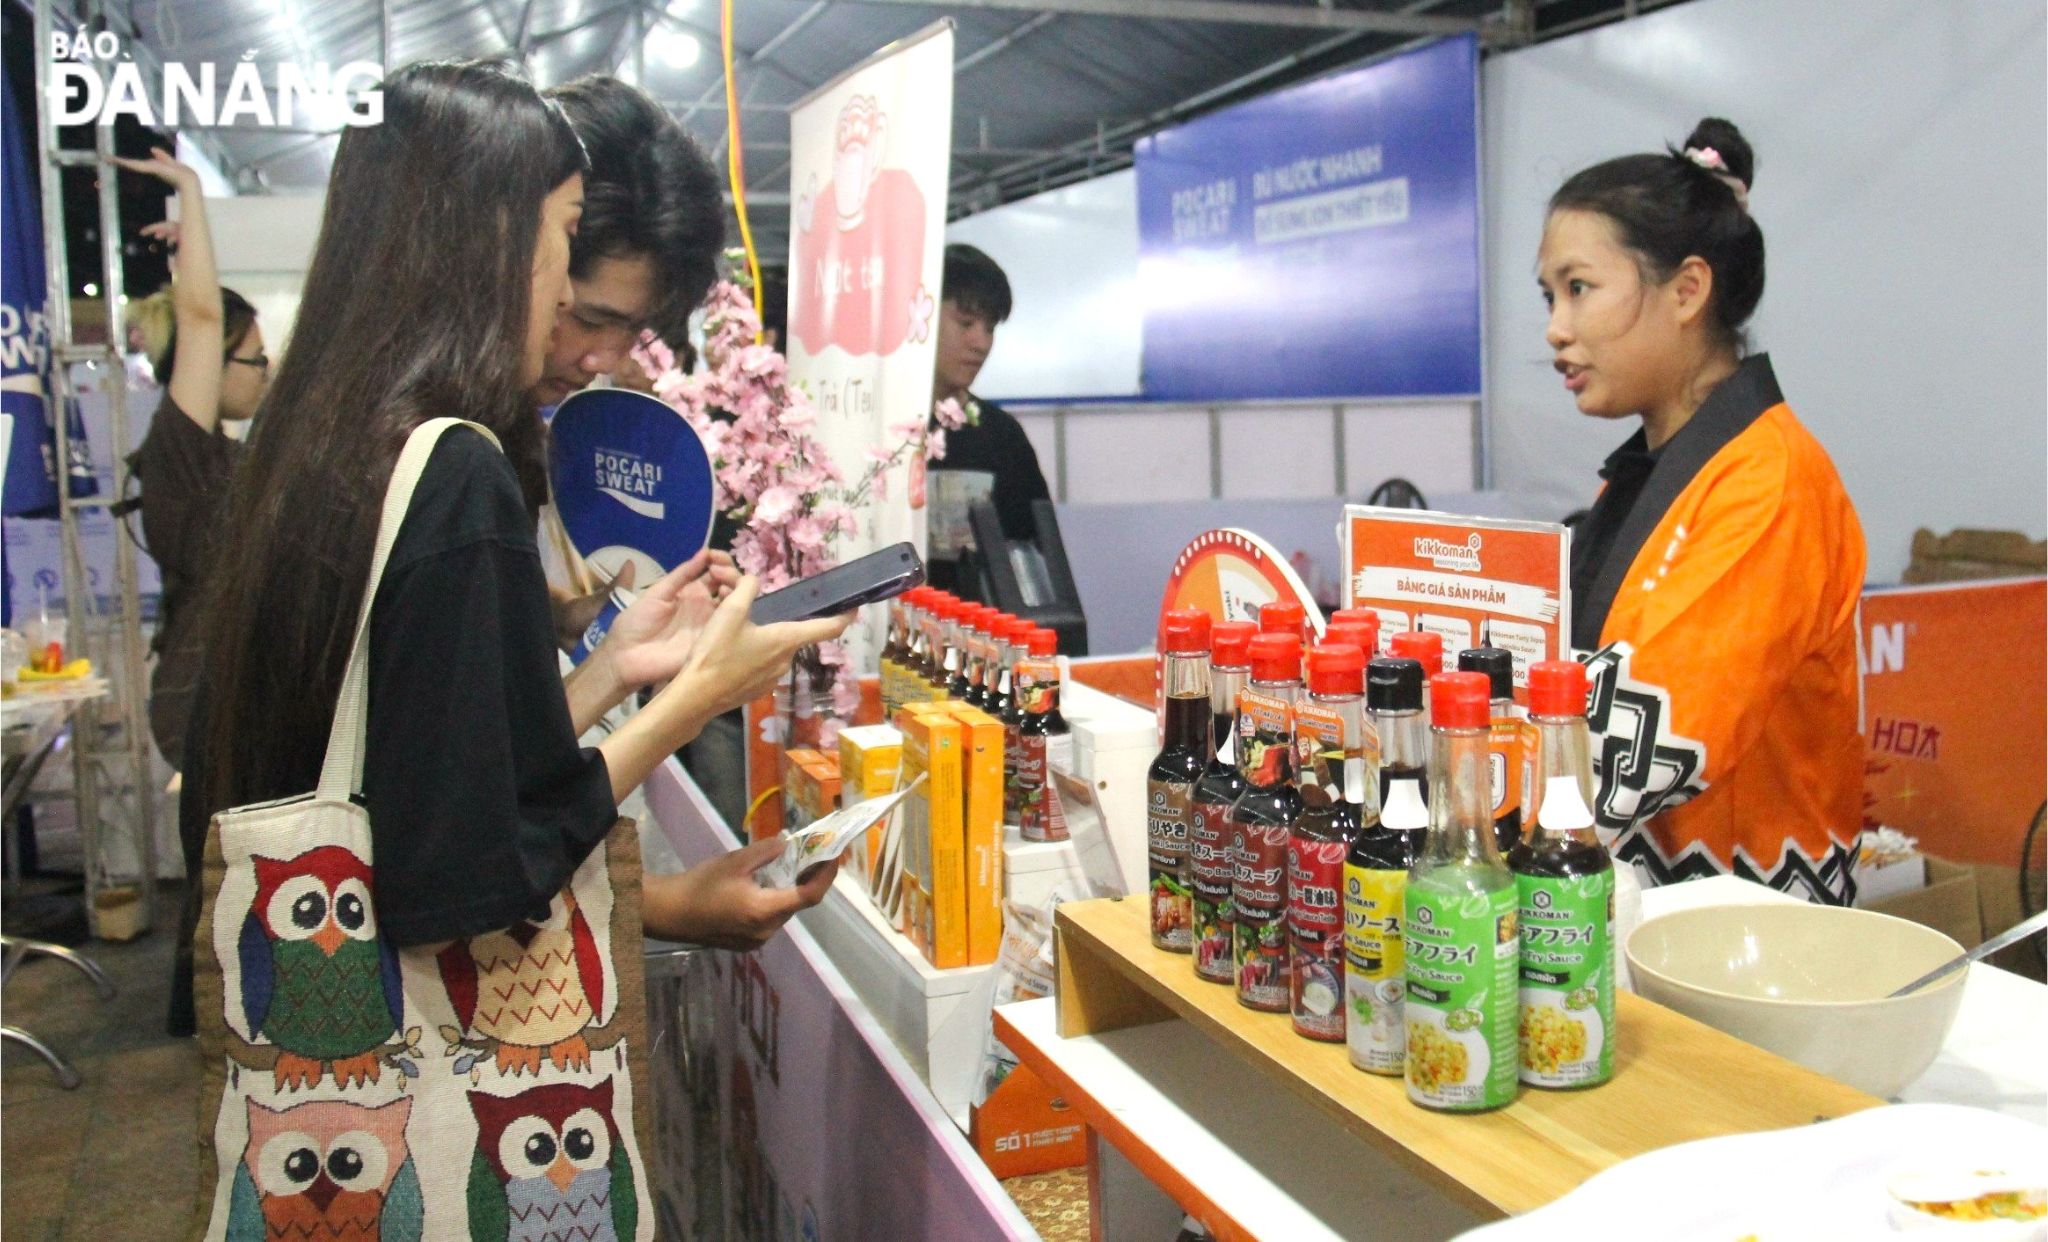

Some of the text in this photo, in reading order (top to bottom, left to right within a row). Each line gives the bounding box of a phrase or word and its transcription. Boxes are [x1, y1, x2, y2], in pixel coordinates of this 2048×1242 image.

[1172, 176, 1237, 214] POCARI
[595, 453, 662, 482] POCARI
[595, 469, 656, 497] SWEAT
[1415, 538, 1477, 560] kikkoman
[1397, 576, 1506, 605] BẢNG GIÁ SẢN PHẨM
[1872, 717, 1941, 761] HOA
[1215, 867, 1233, 878] Bas
[1548, 951, 1582, 963] Sauce
[1428, 969, 1463, 982] Sauce
[994, 1128, 1032, 1153] SỐ 1
